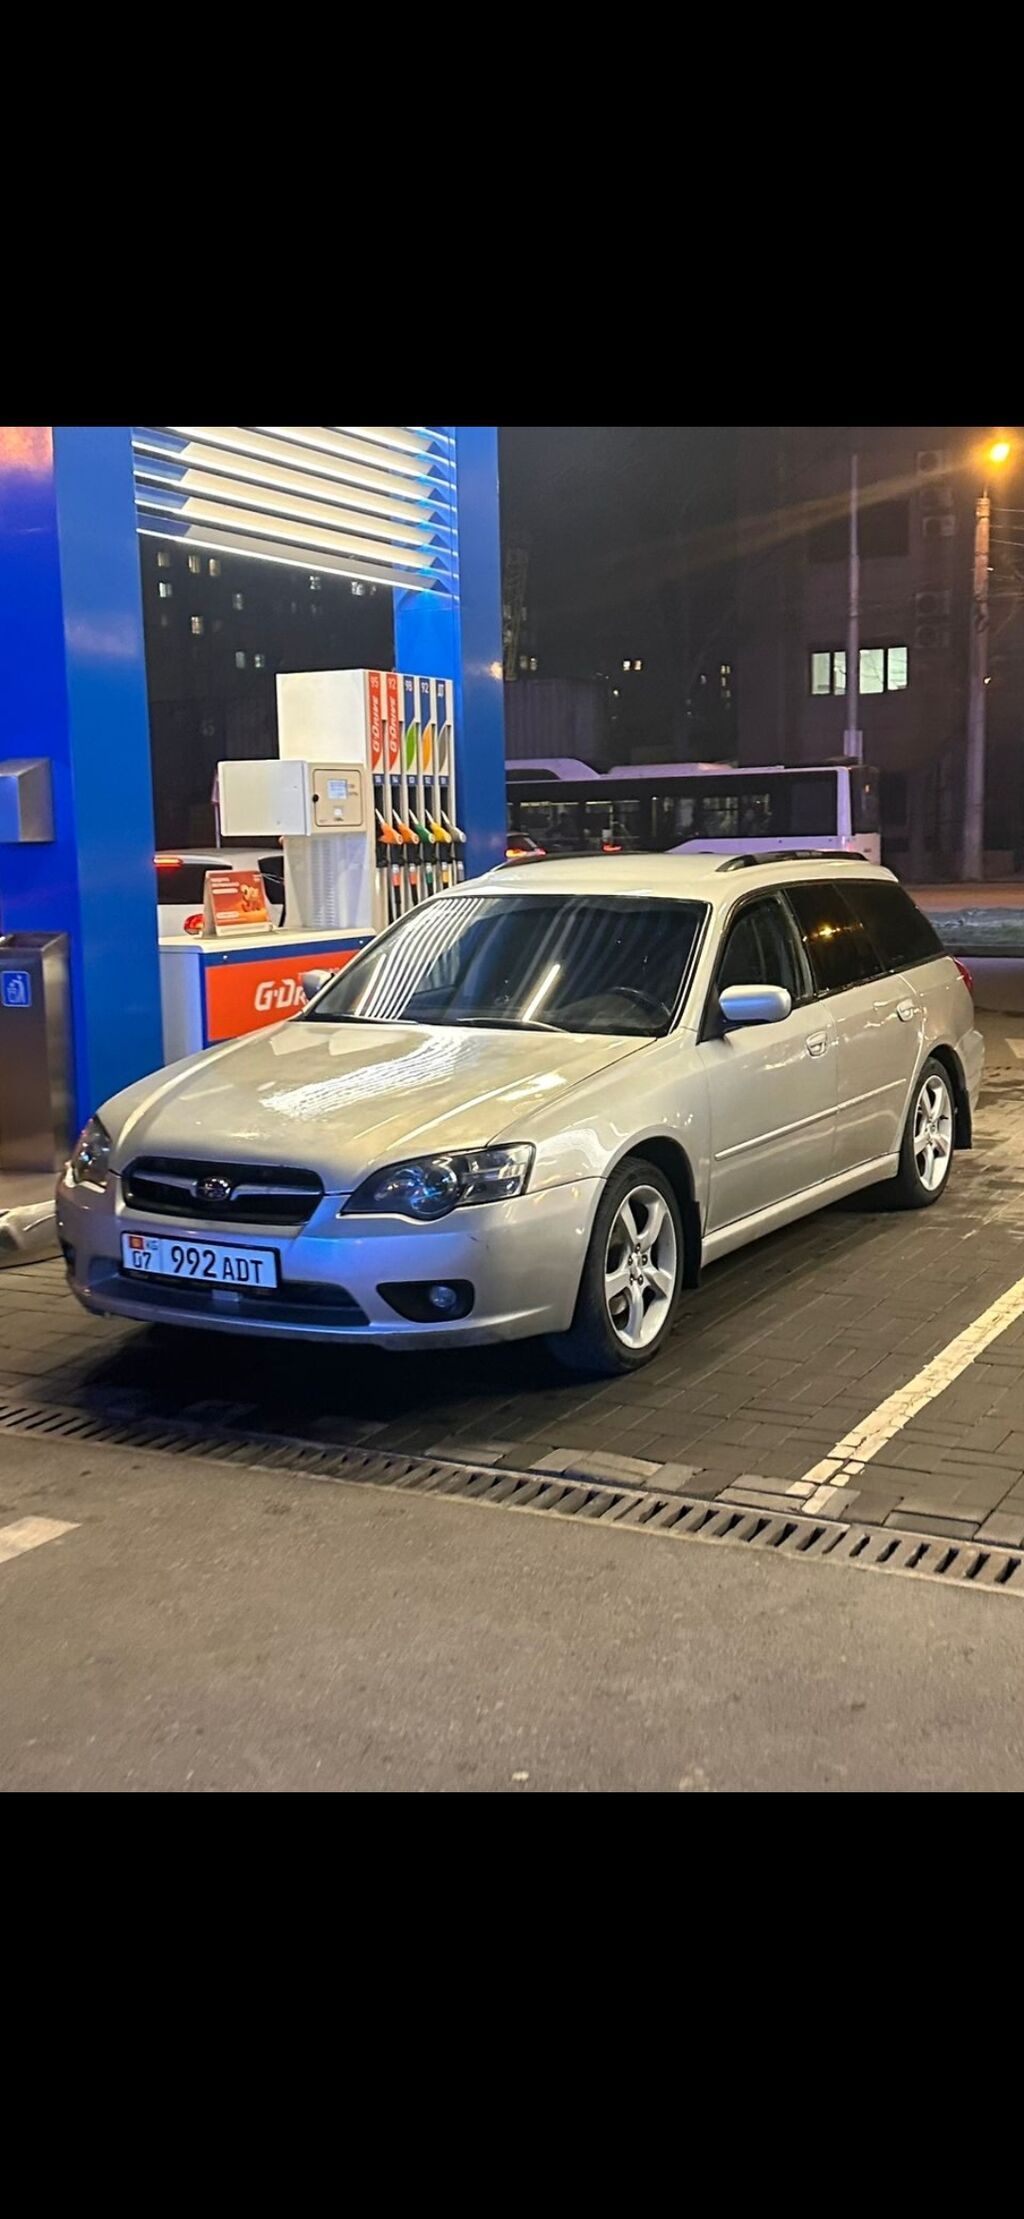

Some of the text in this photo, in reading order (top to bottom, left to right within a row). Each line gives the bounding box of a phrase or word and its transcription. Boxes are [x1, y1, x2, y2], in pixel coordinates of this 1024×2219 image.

[421, 682, 430, 694] 92
[132, 1250, 152, 1270] 07
[171, 1245, 264, 1284] 992 ADT
